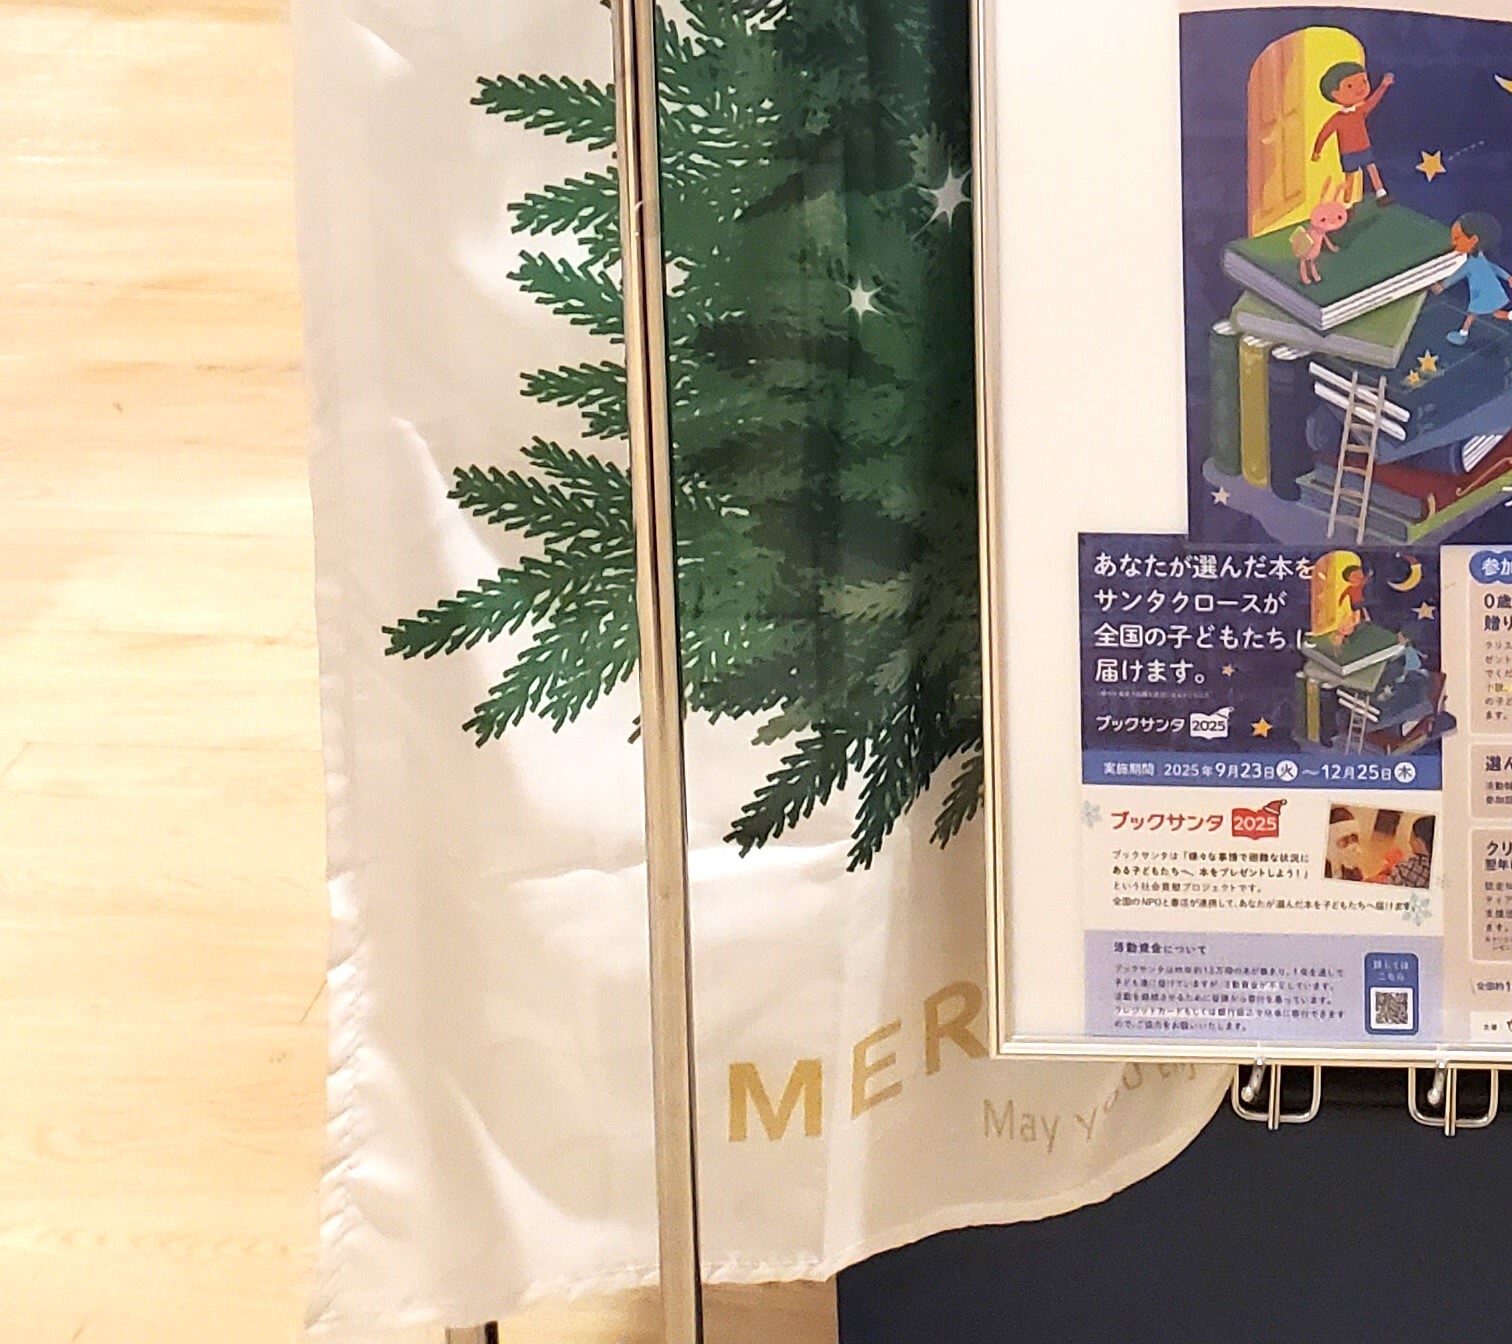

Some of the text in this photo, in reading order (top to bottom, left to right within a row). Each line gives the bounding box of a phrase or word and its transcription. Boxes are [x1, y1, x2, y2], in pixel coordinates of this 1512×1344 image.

[1094, 552, 1316, 580] あなたが選んだ本を
[1094, 590, 1287, 615] サンタクロースが
[1094, 622, 1318, 650] 全国の子どもたちに
[1094, 658, 1206, 684] 届けます。
[1096, 715, 1226, 732] ブックサンタ 2025
[1110, 811, 1278, 833] ブックサンタ 2025
[728, 980, 990, 1142] MER
[983, 1099, 1060, 1153] May
